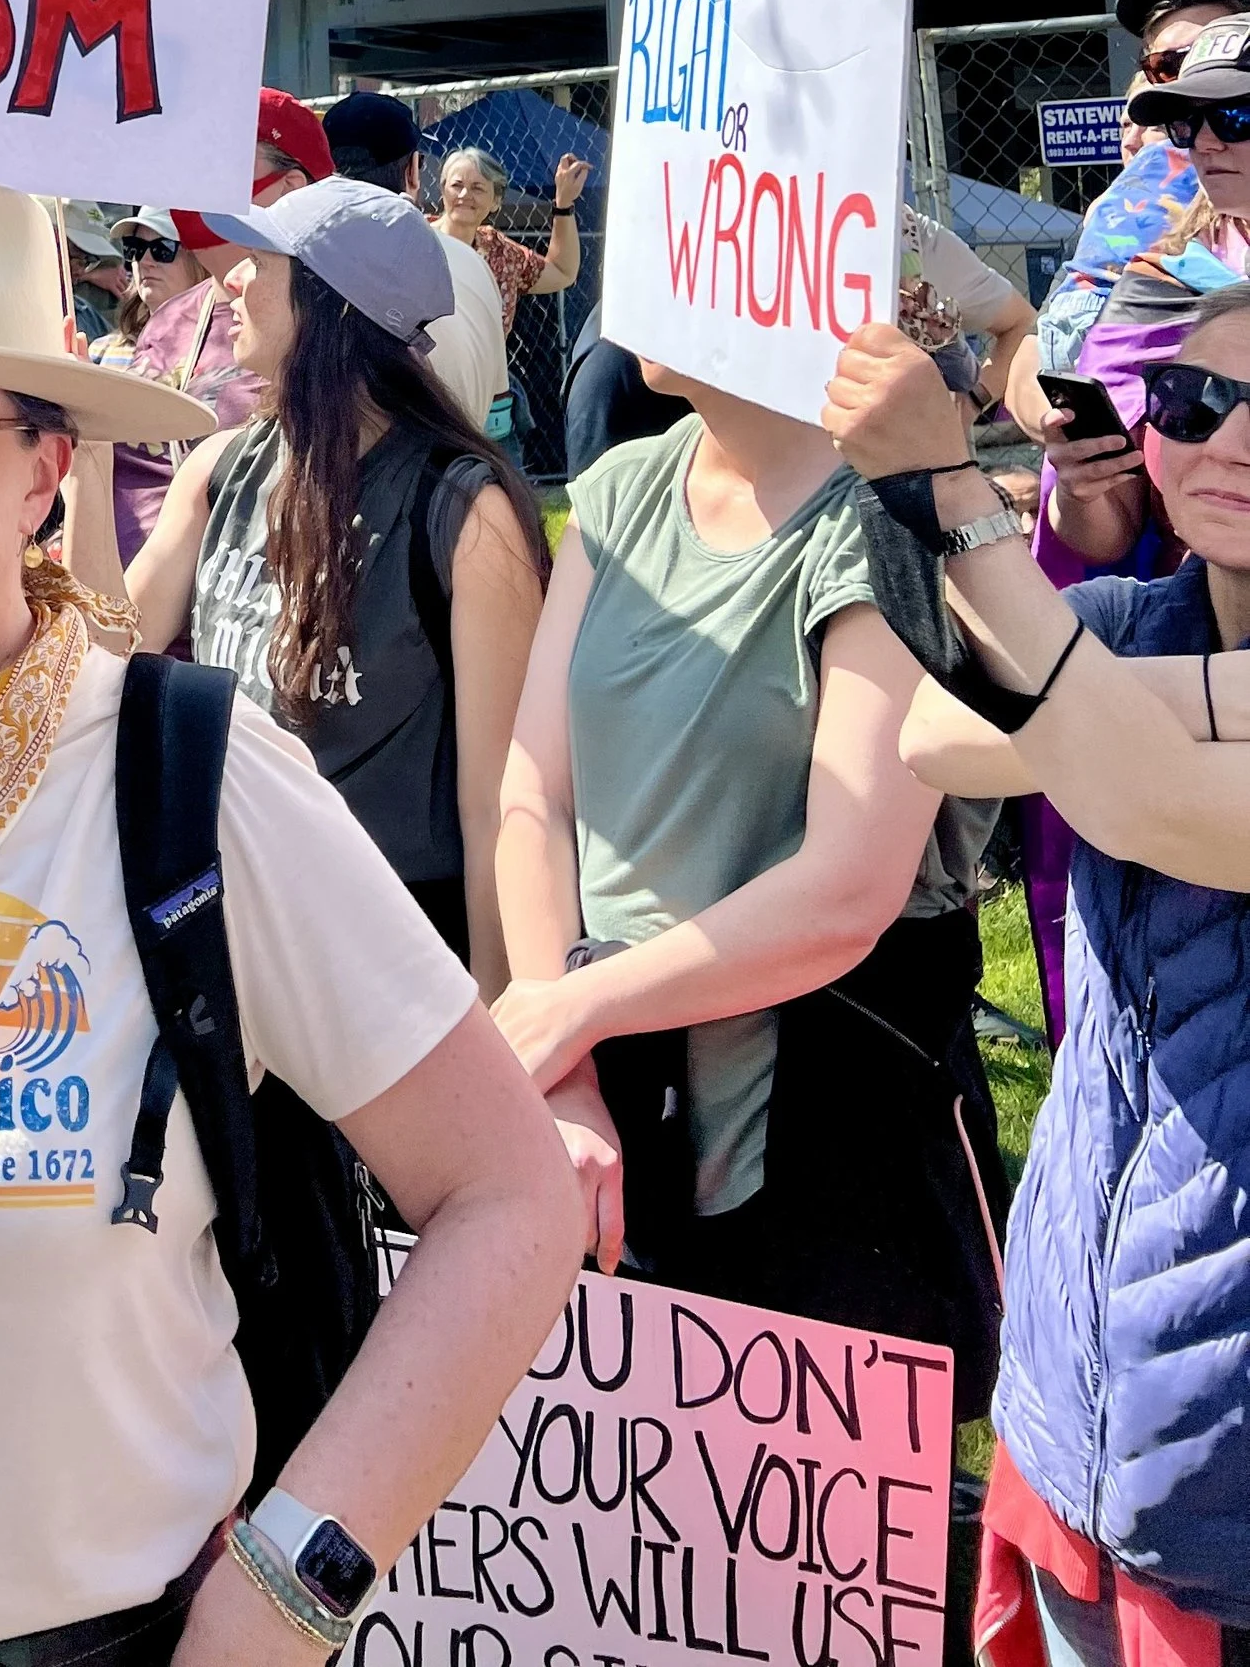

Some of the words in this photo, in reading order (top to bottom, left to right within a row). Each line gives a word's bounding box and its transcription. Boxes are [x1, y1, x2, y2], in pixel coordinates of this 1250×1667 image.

[721, 103, 747, 153] OR
[1044, 104, 1126, 127] STATEWI
[1046, 128, 1123, 145] RENT-A-FE
[664, 154, 876, 344] WRONG
[163, 886, 218, 929] patagonia
[28, 1148, 95, 1182] 1672
[526, 1284, 633, 1392] OU
[672, 1303, 946, 1454] DON'T
[498, 1396, 681, 1542] YOUR
[695, 1430, 936, 1598] VOICE
[574, 1522, 769, 1661] WILL
[792, 1581, 946, 1667] USE
